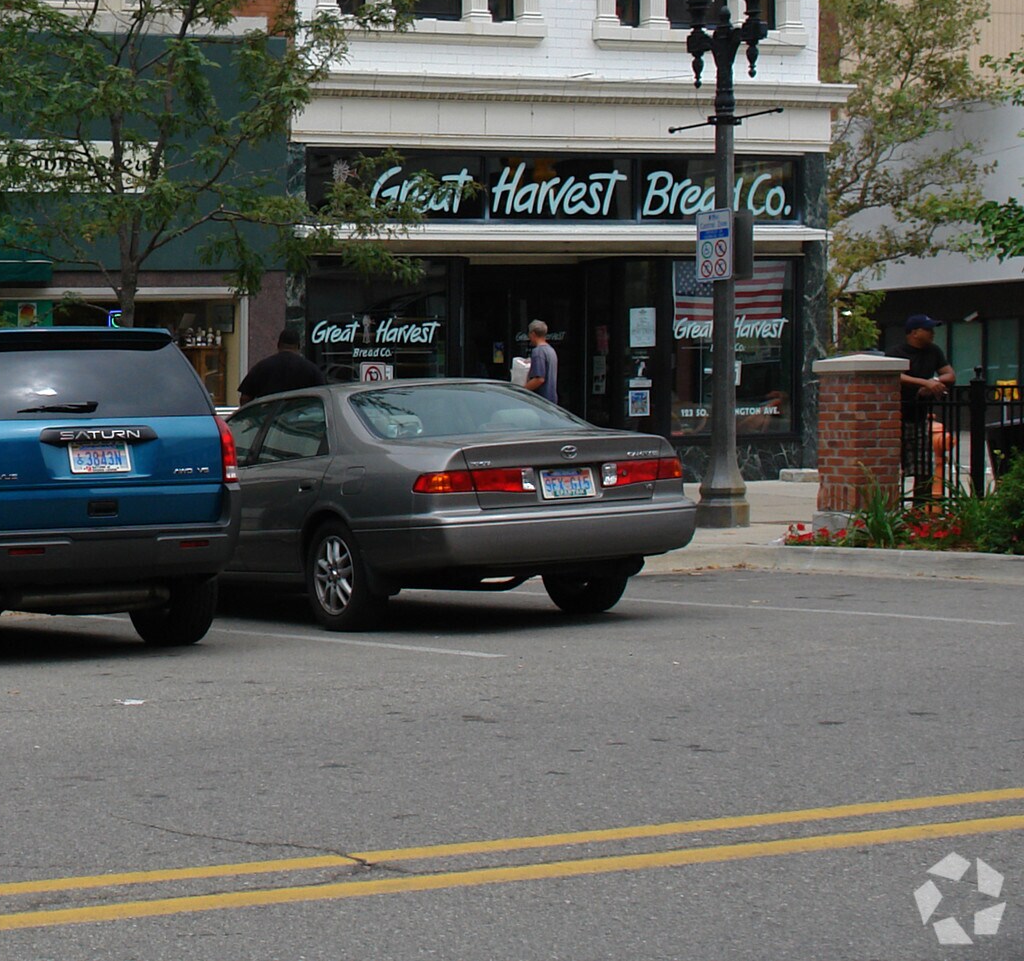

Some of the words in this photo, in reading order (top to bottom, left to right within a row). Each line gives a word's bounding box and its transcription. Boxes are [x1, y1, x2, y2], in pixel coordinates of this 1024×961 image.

[491, 162, 628, 215] Harvest
[747, 173, 792, 216] Co.
[311, 320, 361, 344] Great
[376, 318, 441, 344] Harvest
[674, 317, 714, 339] Great
[734, 315, 789, 339] Harvest
[352, 347, 380, 358] Bread
[380, 347, 393, 357] Co.
[763, 406, 780, 415] AVE.
[59, 429, 141, 440] SATURN
[85, 451, 123, 466] 3843N
